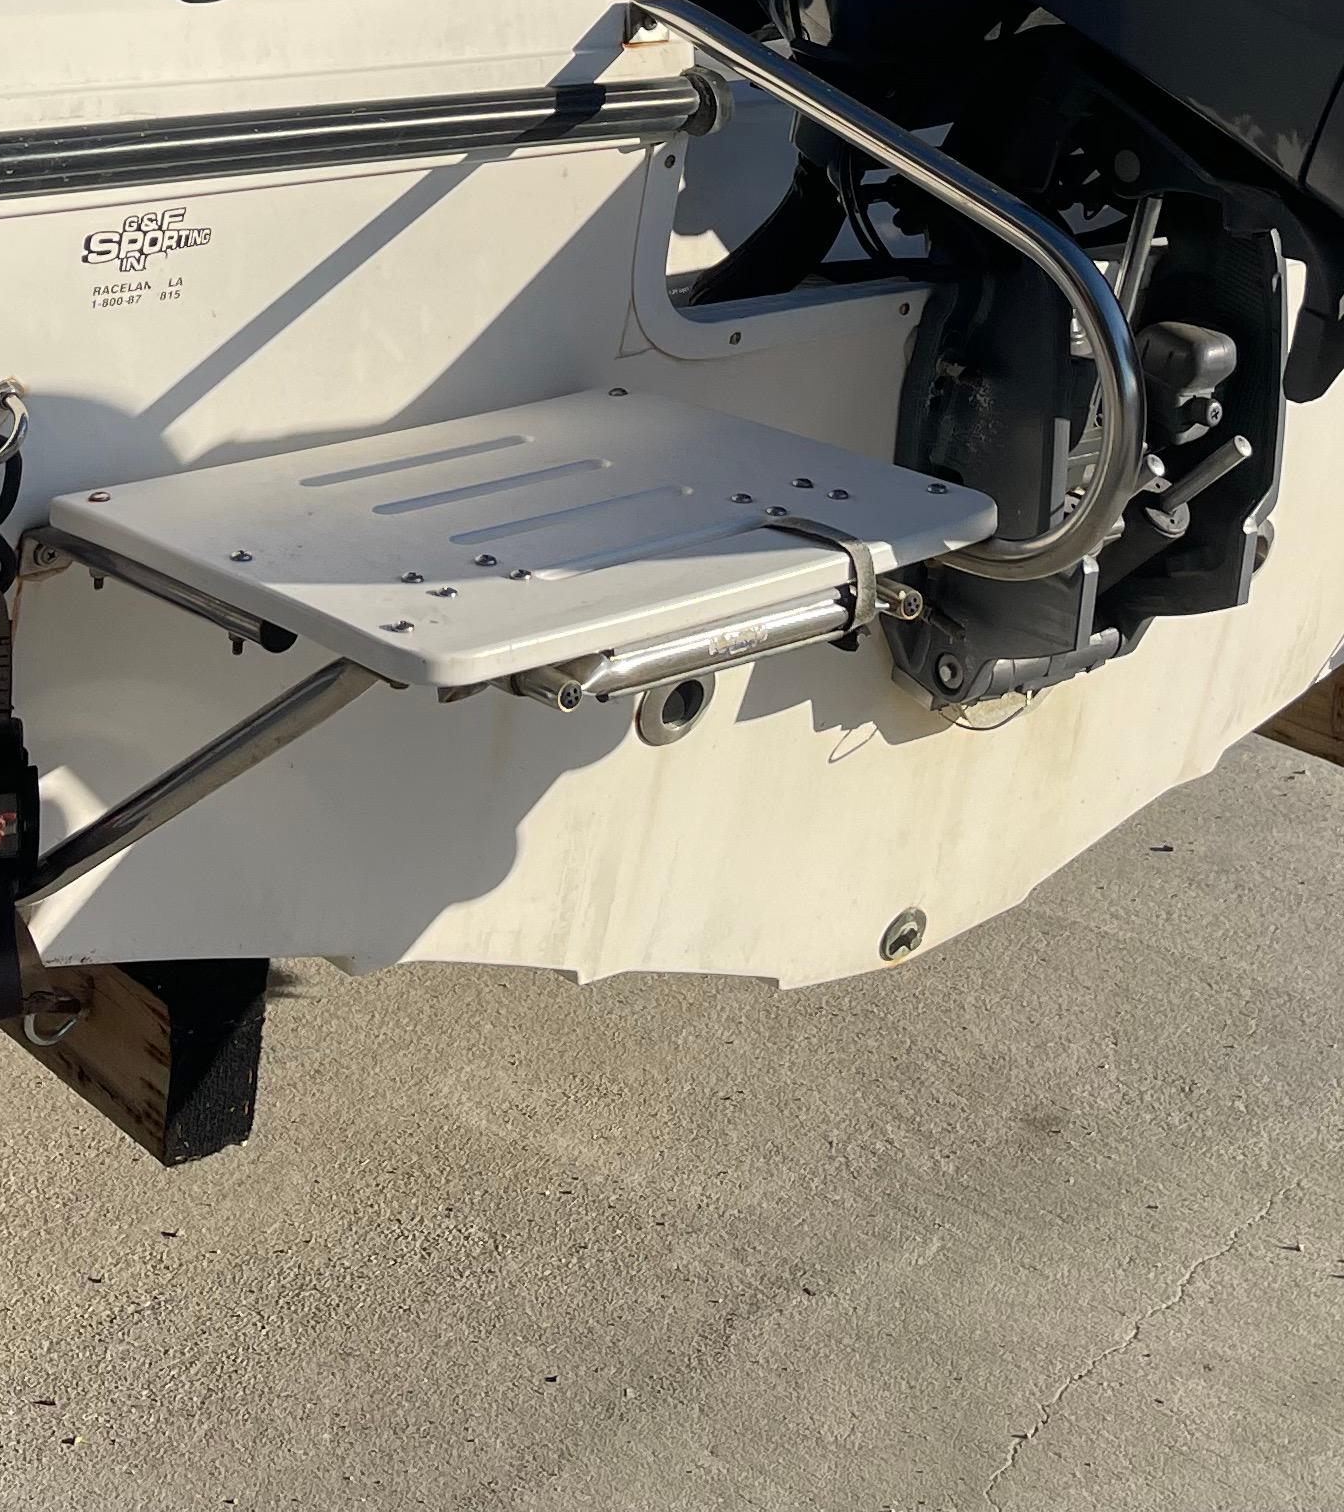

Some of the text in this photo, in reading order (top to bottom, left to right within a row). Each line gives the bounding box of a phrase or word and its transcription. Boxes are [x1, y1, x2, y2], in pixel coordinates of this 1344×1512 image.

[123, 207, 187, 232] G&F
[82, 227, 211, 264] SPORTING
[168, 277, 183, 288] LA
